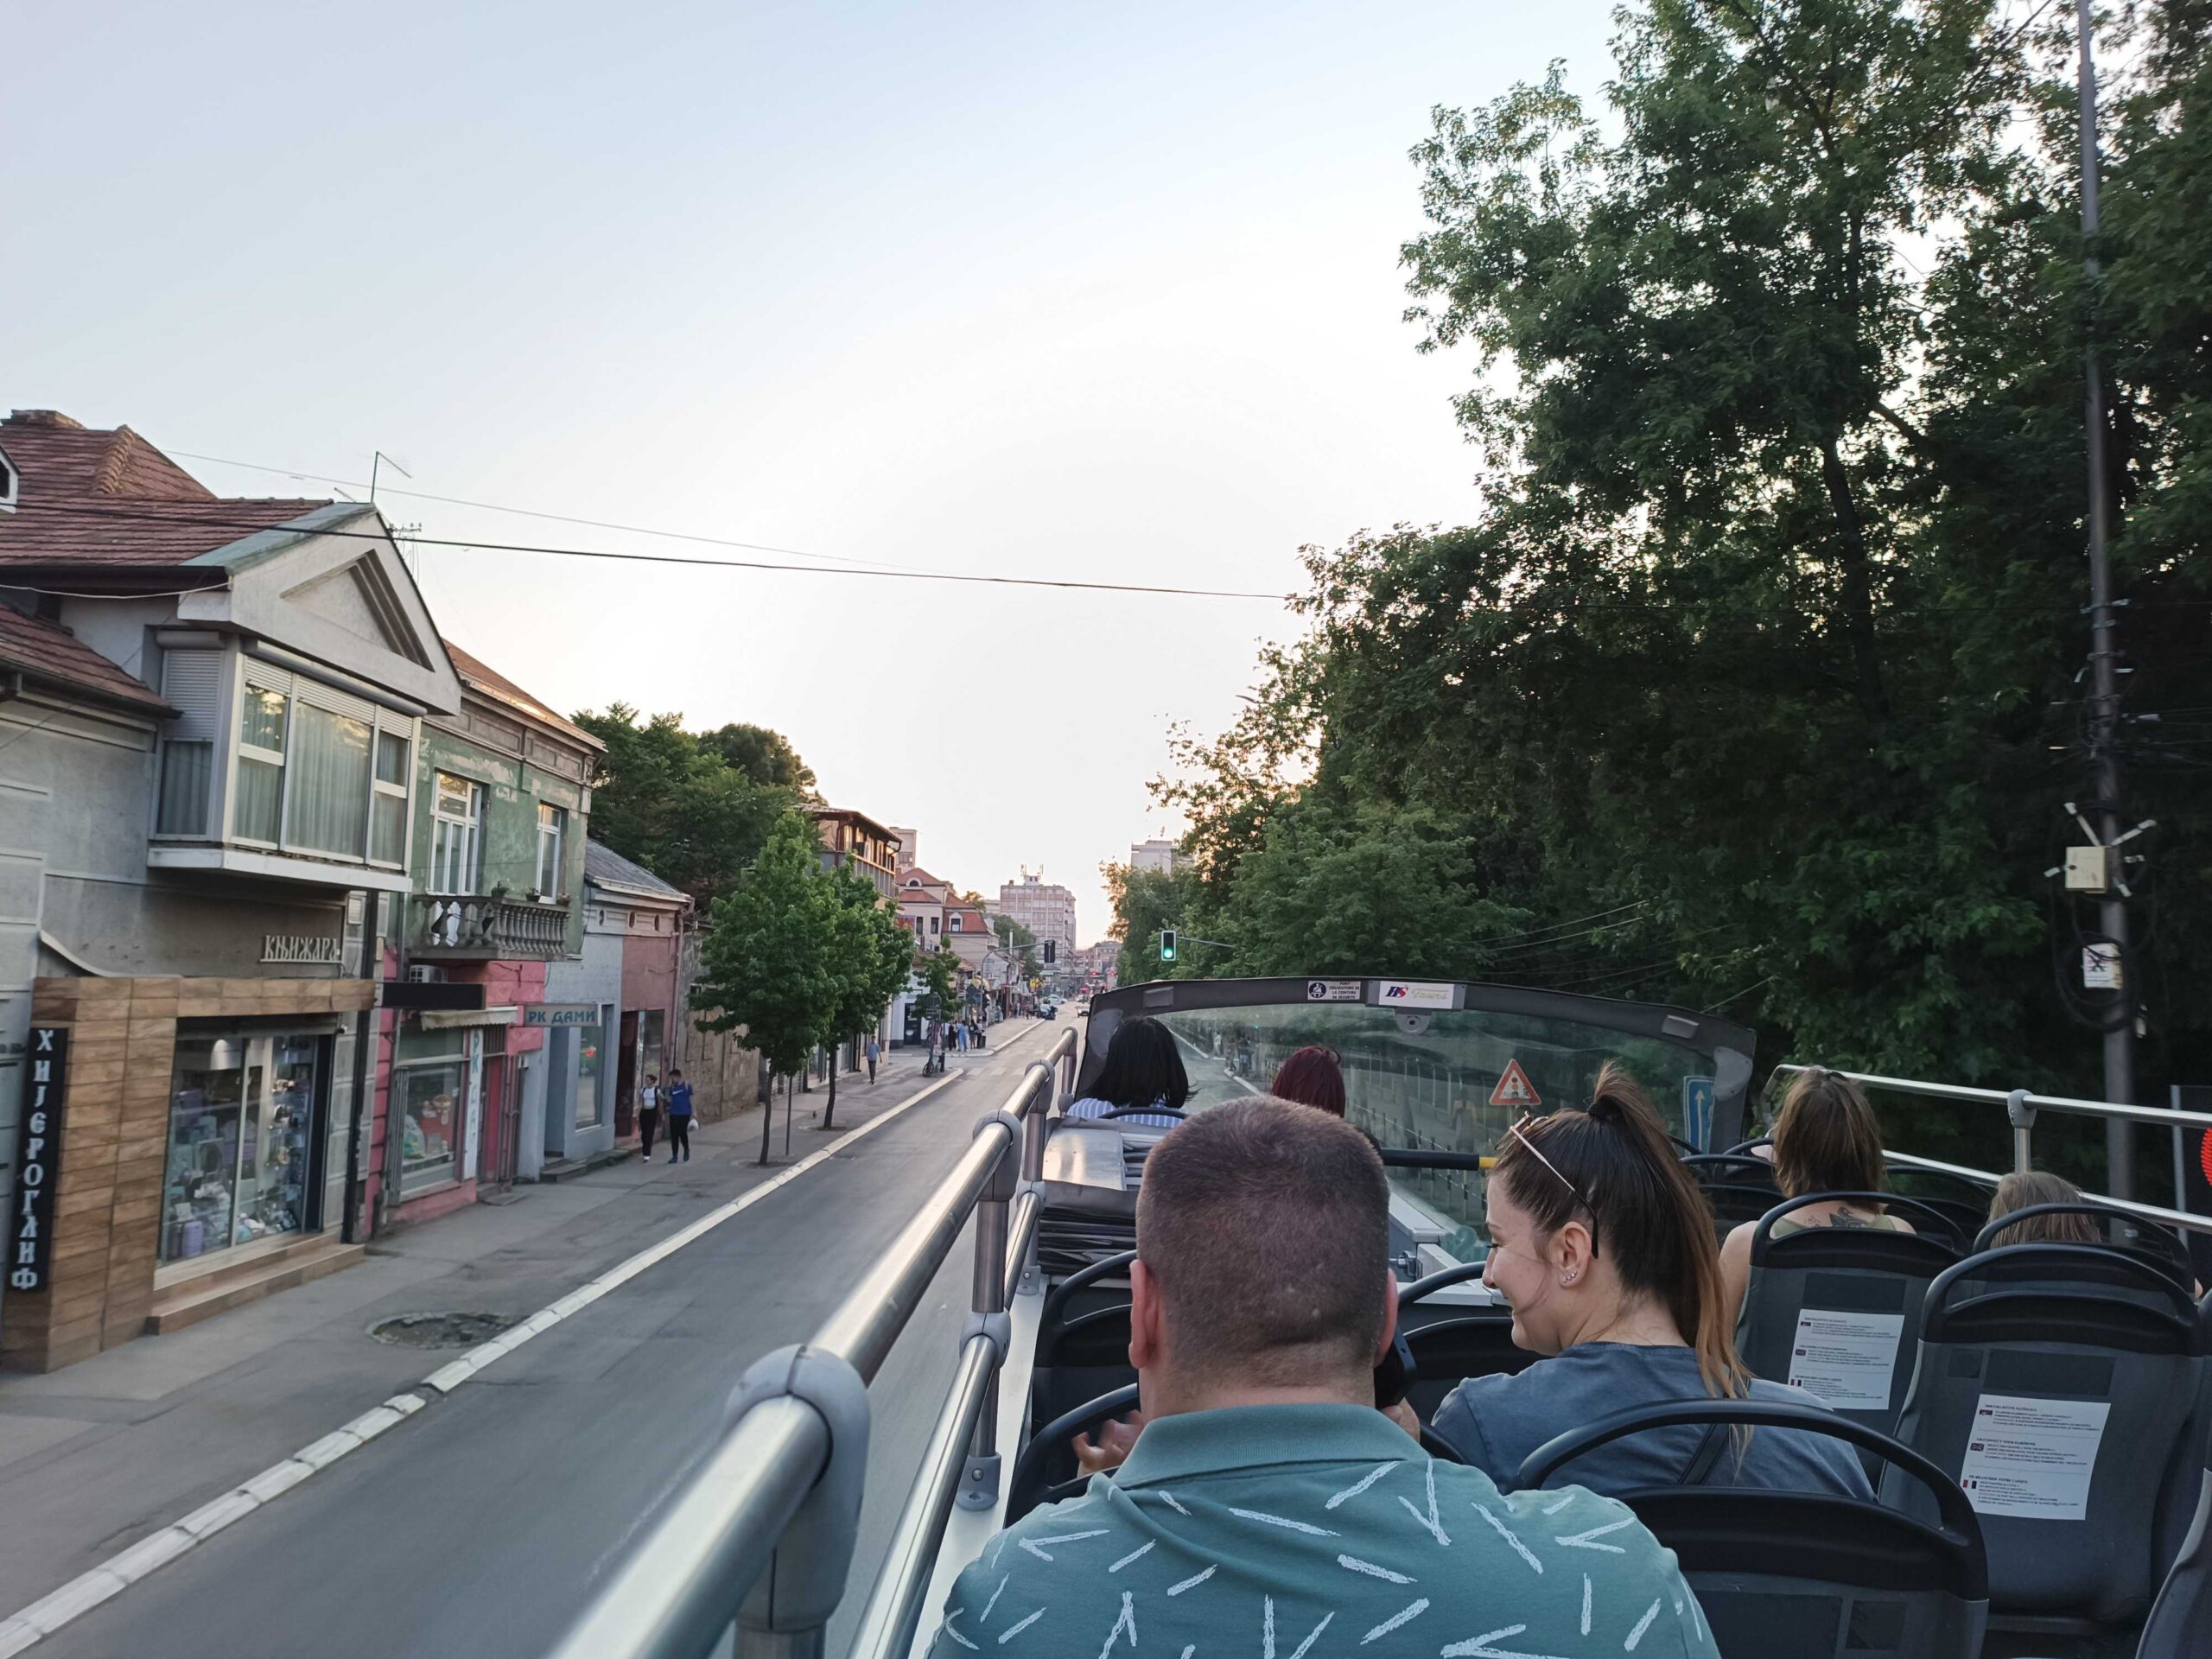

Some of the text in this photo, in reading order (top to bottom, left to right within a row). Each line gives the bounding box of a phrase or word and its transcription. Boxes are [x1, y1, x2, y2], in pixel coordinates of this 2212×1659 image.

[264, 935, 337, 960] КЊИЖАРА
[529, 1011, 595, 1024] РК ДАМИ
